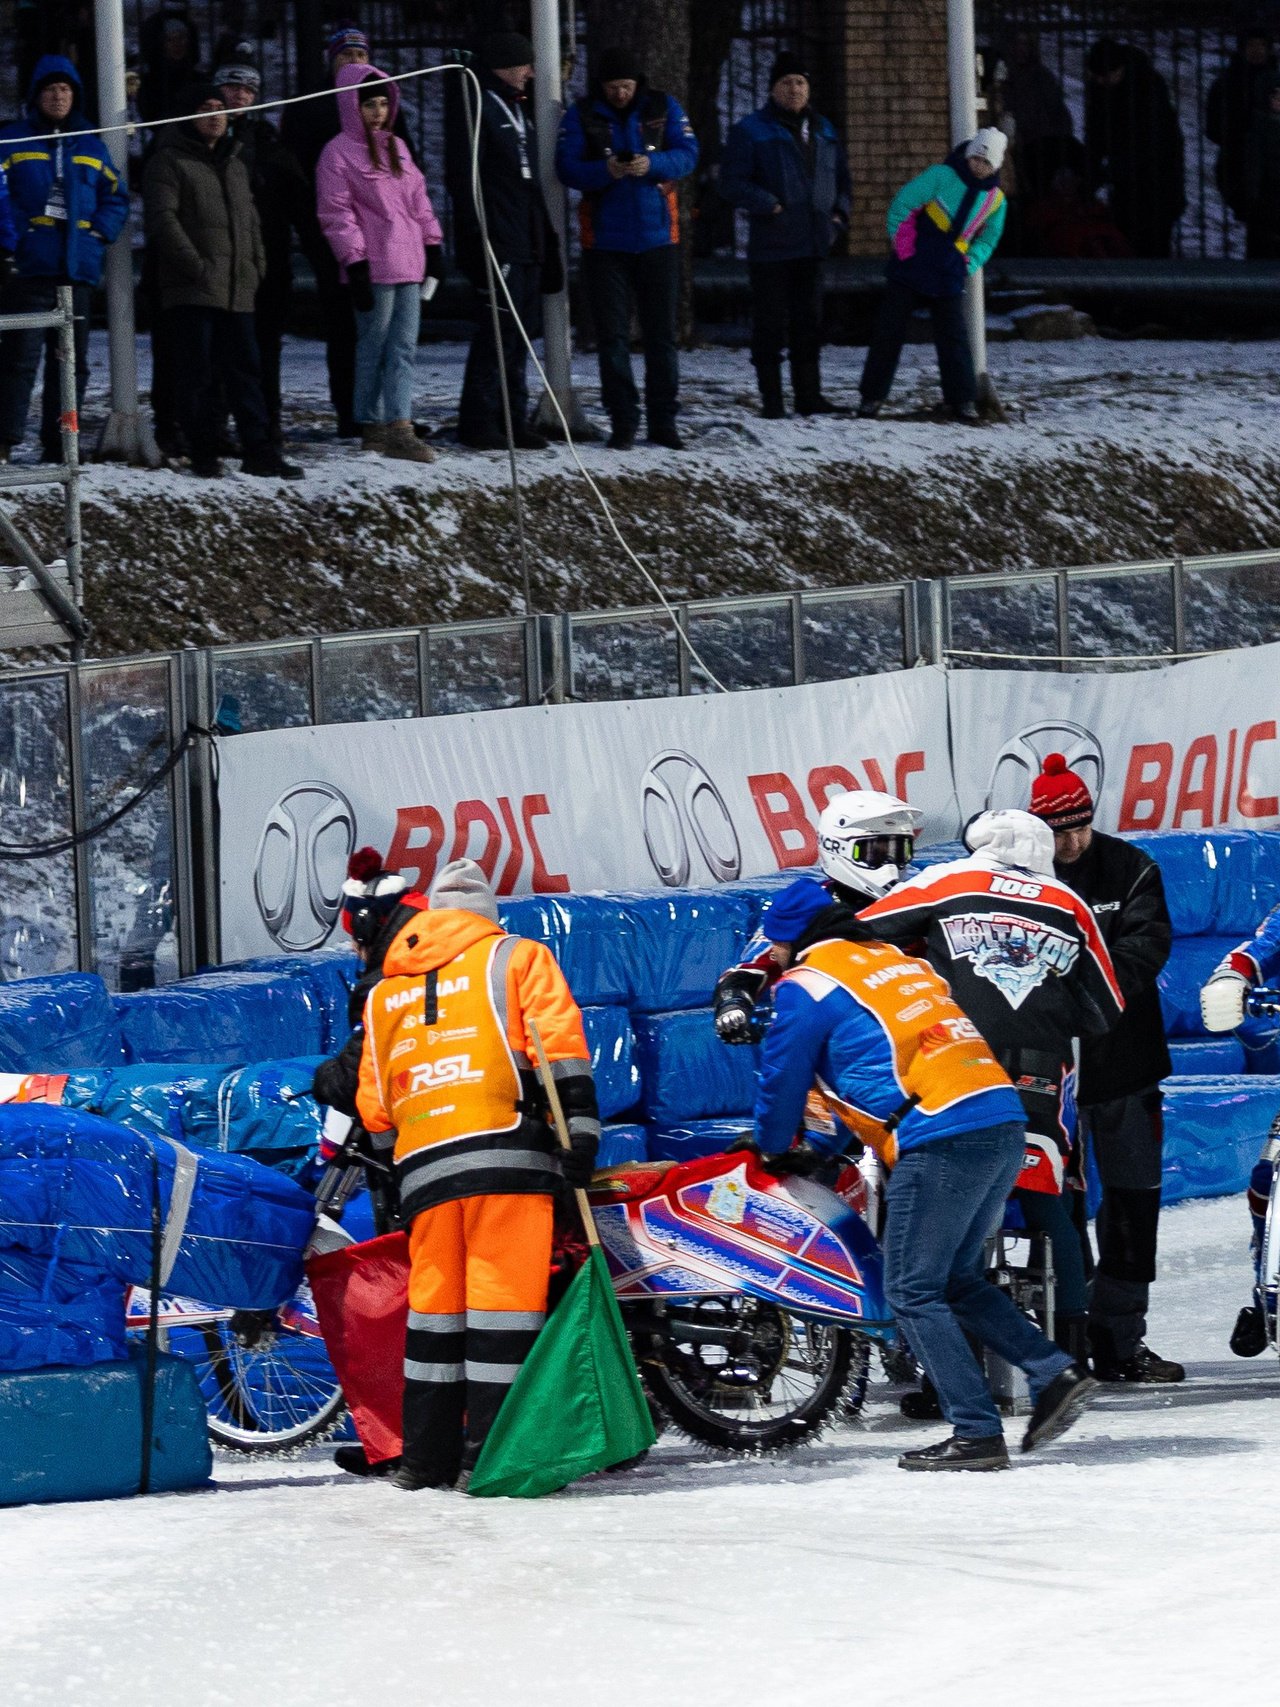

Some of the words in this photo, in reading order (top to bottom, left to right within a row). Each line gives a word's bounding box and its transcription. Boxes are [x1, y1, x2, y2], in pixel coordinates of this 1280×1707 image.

[1117, 720, 1279, 831] BAIC
[989, 875, 1043, 898] 106
[408, 1054, 486, 1093] RSL
